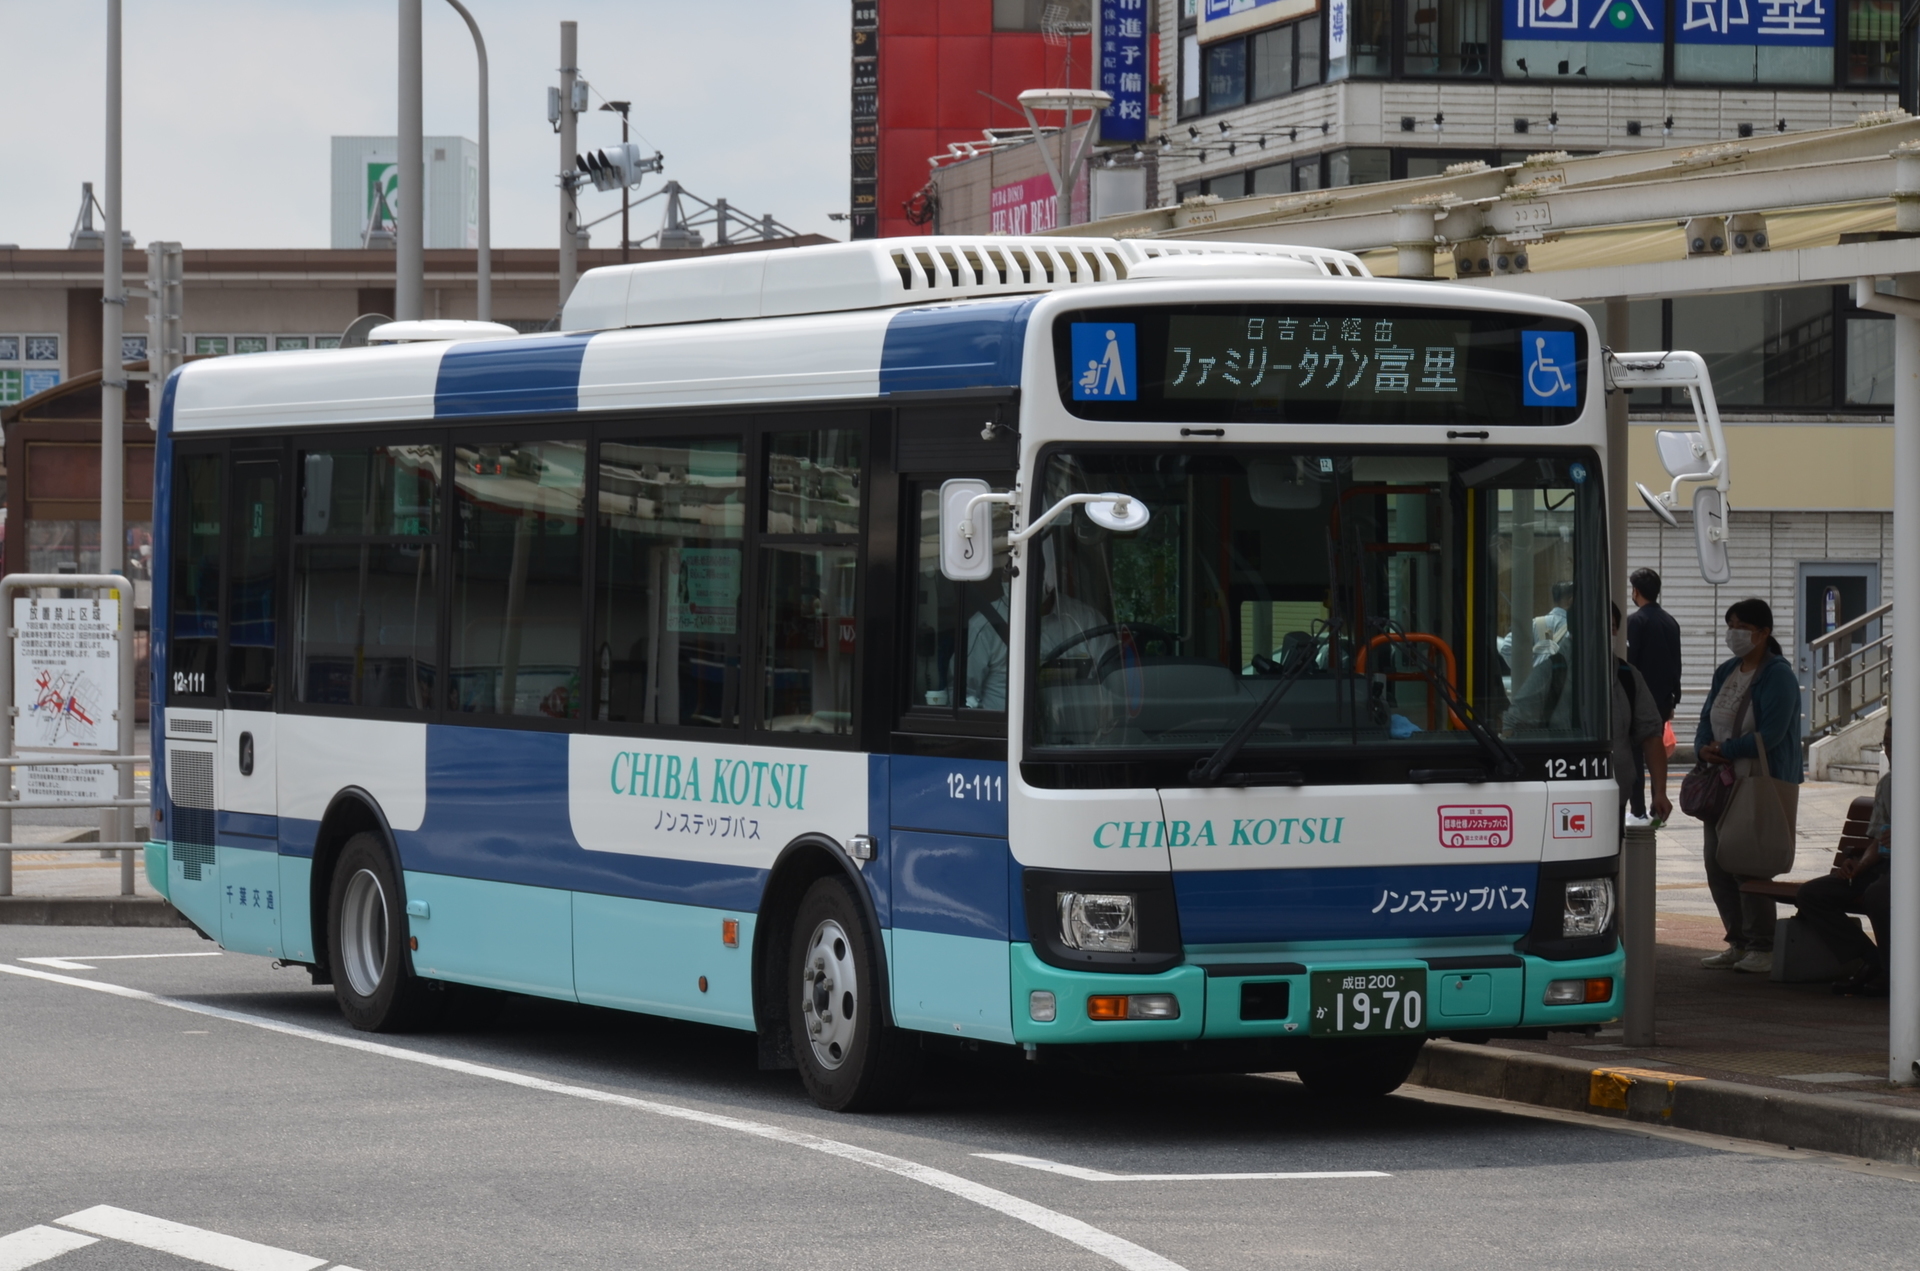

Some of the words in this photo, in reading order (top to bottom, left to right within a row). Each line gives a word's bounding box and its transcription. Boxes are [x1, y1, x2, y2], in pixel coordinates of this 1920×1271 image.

[1030, 195, 1058, 233] BEAT
[1248, 317, 1393, 342] 日吉台経由
[1172, 345, 1458, 394] ファミリータウン富里
[29, 606, 101, 621] 放置禁止区域
[173, 671, 205, 693] 12-111
[610, 751, 702, 802] CHIBA
[710, 758, 809, 811] KOTSU
[1545, 757, 1608, 778] 12-111
[947, 772, 1002, 802] 12-111
[654, 810, 761, 840] ノンステップバス
[1092, 820, 1218, 849] CHIBA
[1228, 817, 1346, 847] KOTSU
[1443, 818, 1508, 830] 標準仕様ノンステップバス
[226, 885, 275, 910] 千葉交通
[1371, 885, 1530, 914] ノンステップバス
[1342, 976, 1366, 990] 成田
[1368, 974, 1396, 989] 200
[1316, 1006, 1328, 1019] か
[1336, 990, 1422, 1031] 19-70
